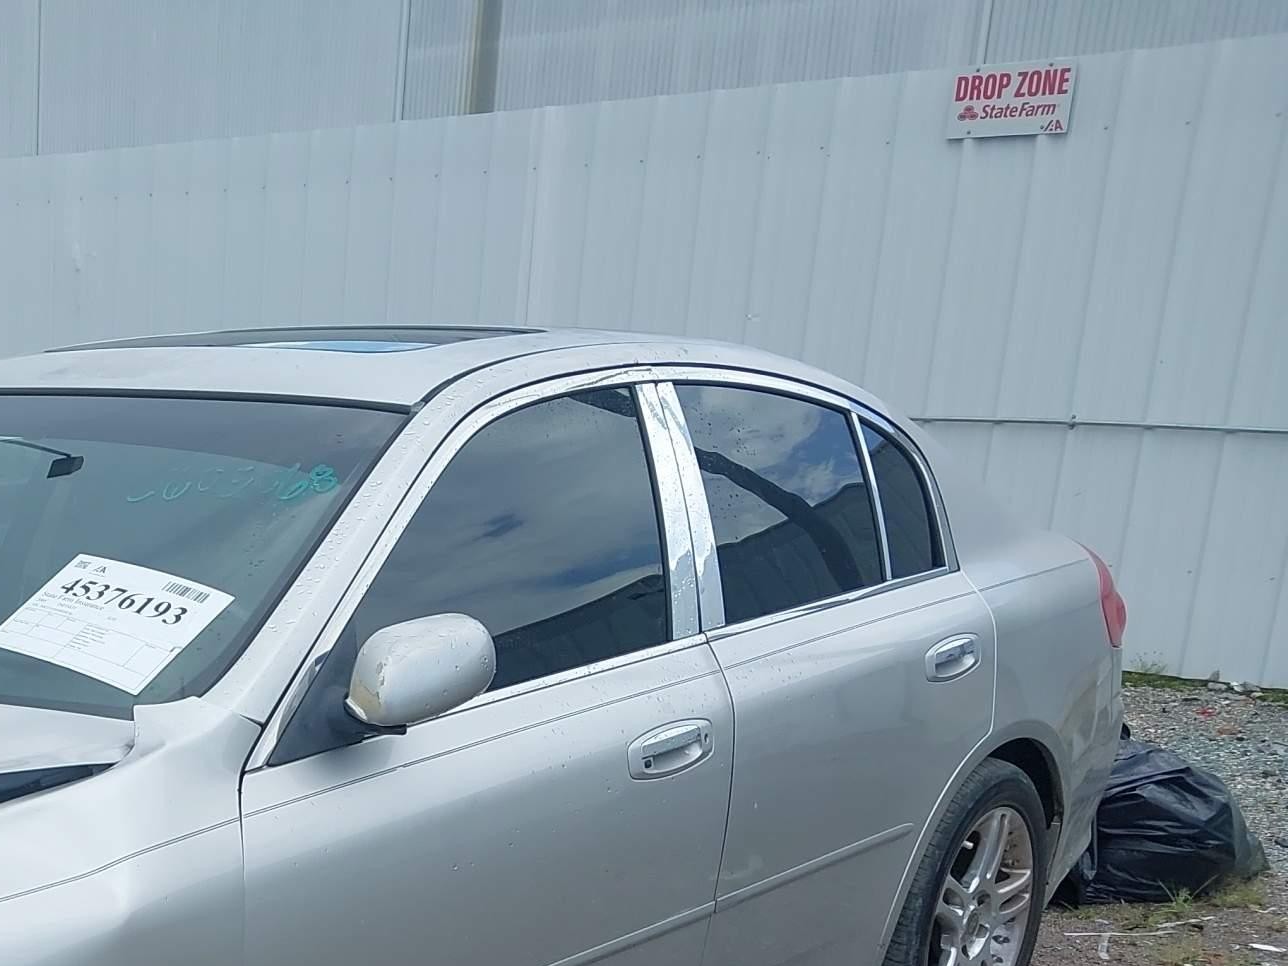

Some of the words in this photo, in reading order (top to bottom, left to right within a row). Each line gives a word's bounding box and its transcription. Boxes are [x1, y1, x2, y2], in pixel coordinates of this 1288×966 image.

[955, 73, 1011, 102] DROP
[1014, 67, 1072, 98] ZONE
[60, 577, 188, 625] 45376193
